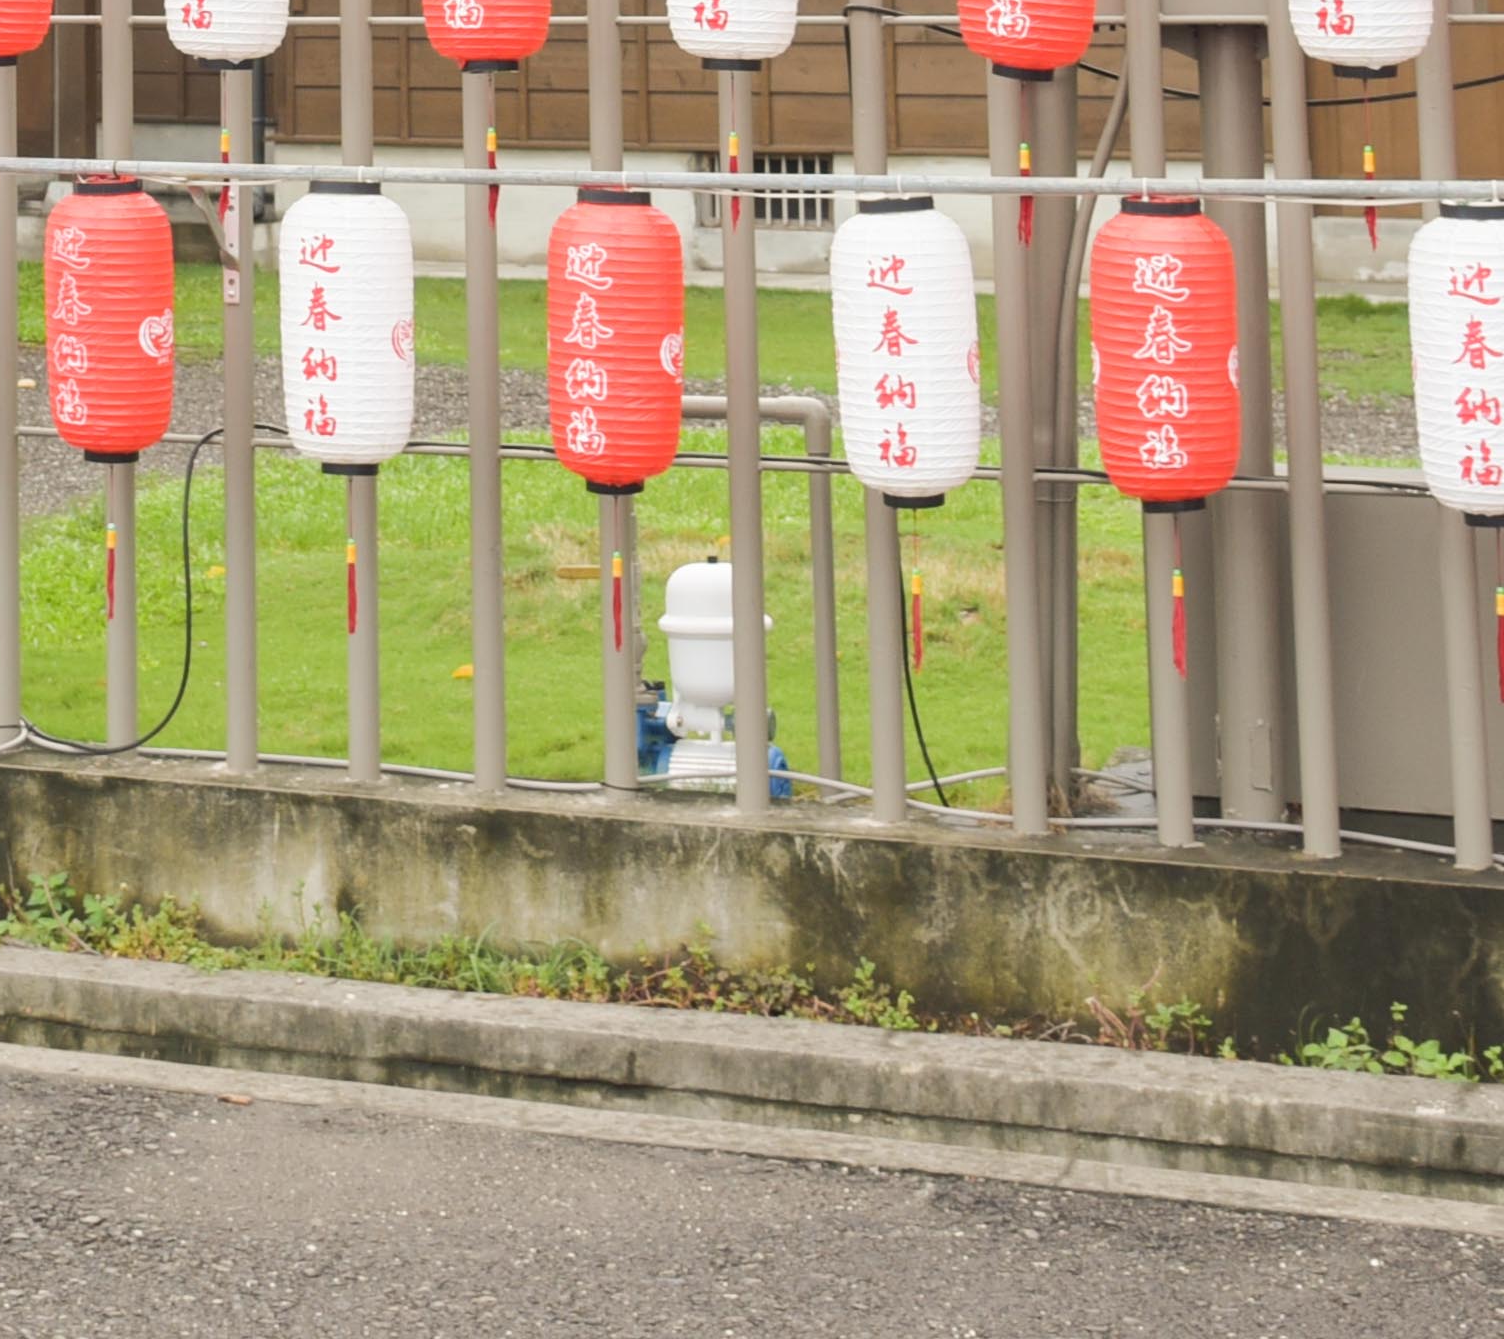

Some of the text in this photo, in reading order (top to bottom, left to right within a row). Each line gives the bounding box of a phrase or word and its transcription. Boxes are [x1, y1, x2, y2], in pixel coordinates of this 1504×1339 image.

[52, 226, 91, 428] 迎春納福
[299, 235, 341, 438] 迎春納福
[565, 243, 615, 457] 迎春納福
[867, 255, 918, 469] 迎春納福
[1133, 252, 1193, 470] 迎春納福
[1448, 263, 1504, 487] 迎春納福
